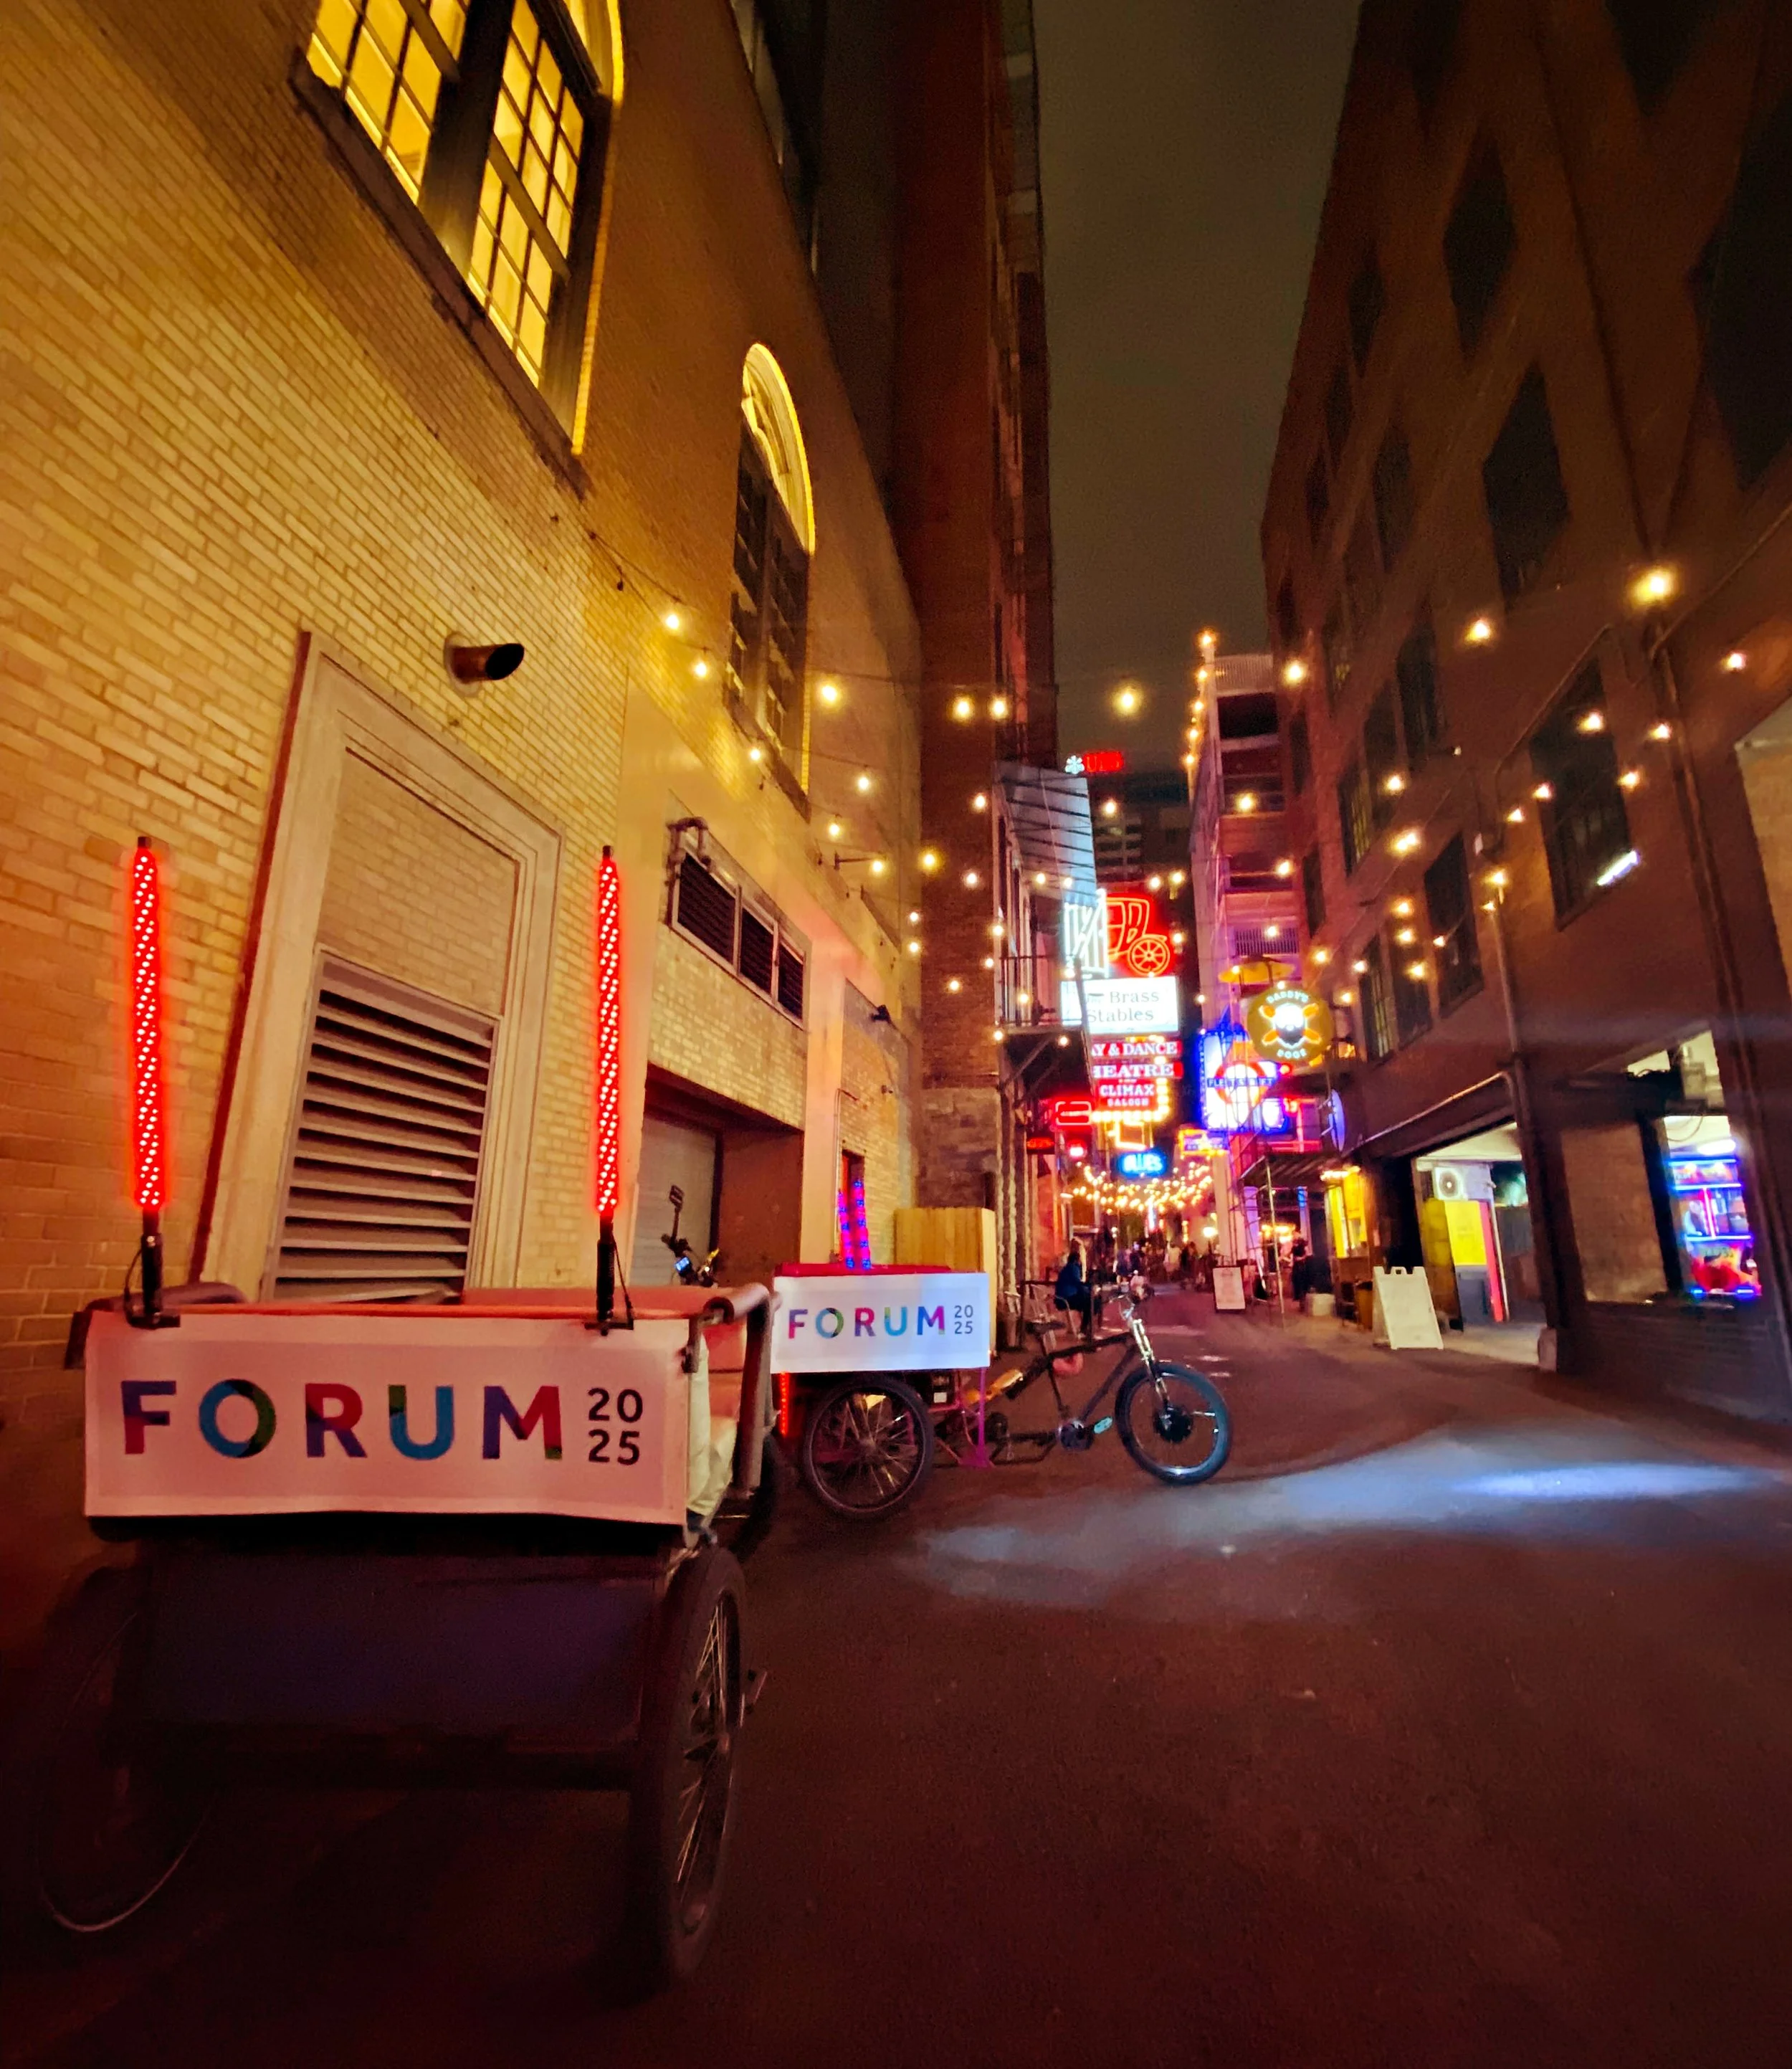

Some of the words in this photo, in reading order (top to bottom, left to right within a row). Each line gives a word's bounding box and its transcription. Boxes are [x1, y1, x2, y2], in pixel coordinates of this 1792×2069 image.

[1110, 991, 1160, 1004] Brass
[1087, 1007, 1155, 1023] Stables
[1108, 1042, 1120, 1057] &
[1123, 1041, 1178, 1056] DANCE
[1100, 1083, 1155, 1098] CLIMAX
[1107, 1097, 1150, 1107] SALOON
[953, 1304, 974, 1319] 20
[788, 1305, 946, 1340] FORUM
[953, 1320, 974, 1335] 25
[587, 1387, 644, 1424] 20
[119, 1377, 564, 1461] FORUM
[587, 1431, 642, 1466] 25
